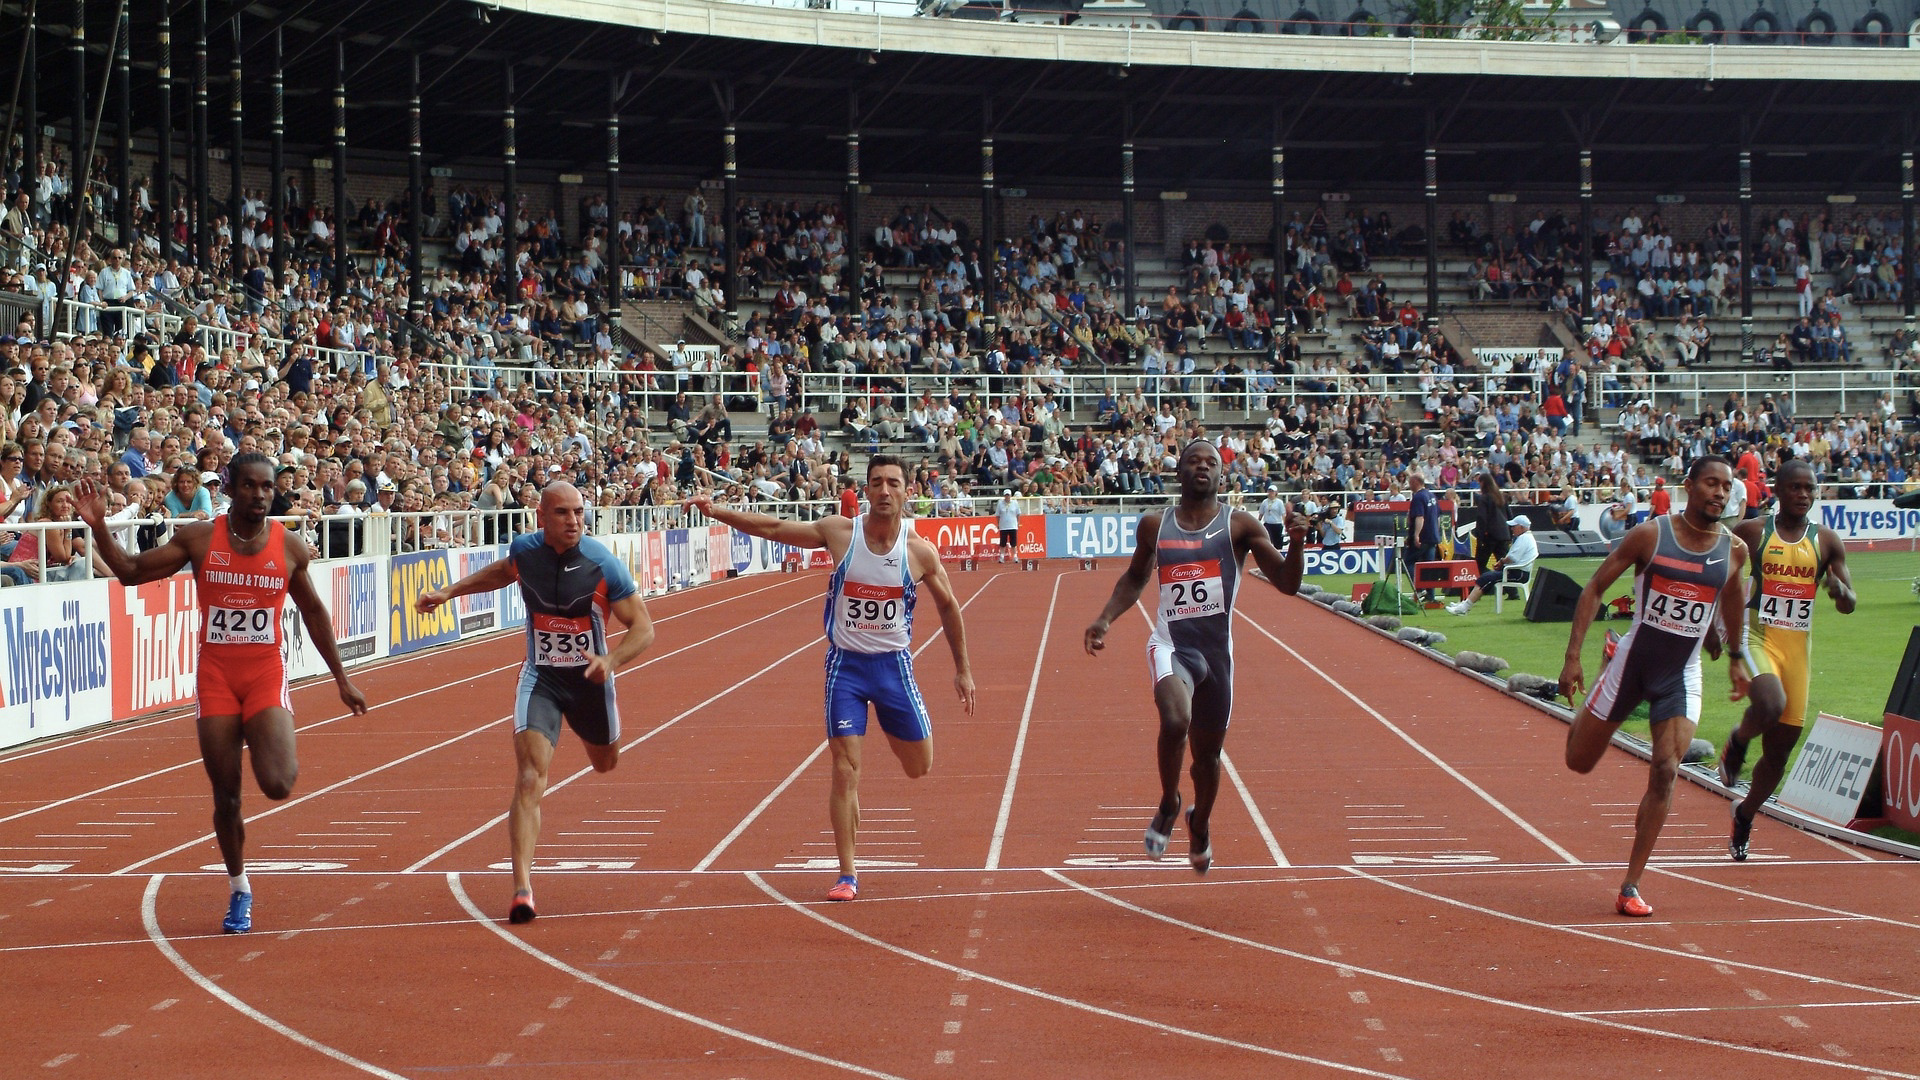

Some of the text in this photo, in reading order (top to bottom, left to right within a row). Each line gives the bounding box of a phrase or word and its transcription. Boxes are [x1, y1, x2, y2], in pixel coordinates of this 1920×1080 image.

[1019, 544, 1044, 553] OMEGA
[1303, 551, 1380, 575] PSON
[1762, 562, 1815, 578] GHANA
[205, 570, 284, 590] TRINIDAD & TOBAGO
[1171, 567, 1203, 578] Carnegie
[1453, 574, 1477, 582] OMEGA
[856, 585, 888, 597] Carnegie
[1170, 580, 1208, 607] 26
[847, 598, 897, 621] 390
[1177, 605, 1201, 615] Galan
[1202, 602, 1220, 612] 2004
[1651, 594, 1705, 624] 430
[1763, 597, 1811, 620] 413
[212, 609, 268, 631] 420
[857, 622, 880, 630] Galan
[1660, 619, 1684, 631] Galan
[1684, 625, 1700, 633] 2004
[1773, 619, 1794, 628] Galan
[211, 632, 269, 642] DN Galan 2004
[538, 632, 590, 654] 339
[3, 599, 107, 728] Myresjöhus
[550, 655, 574, 663] Galan
[1792, 741, 1873, 800] TRIMTEC
